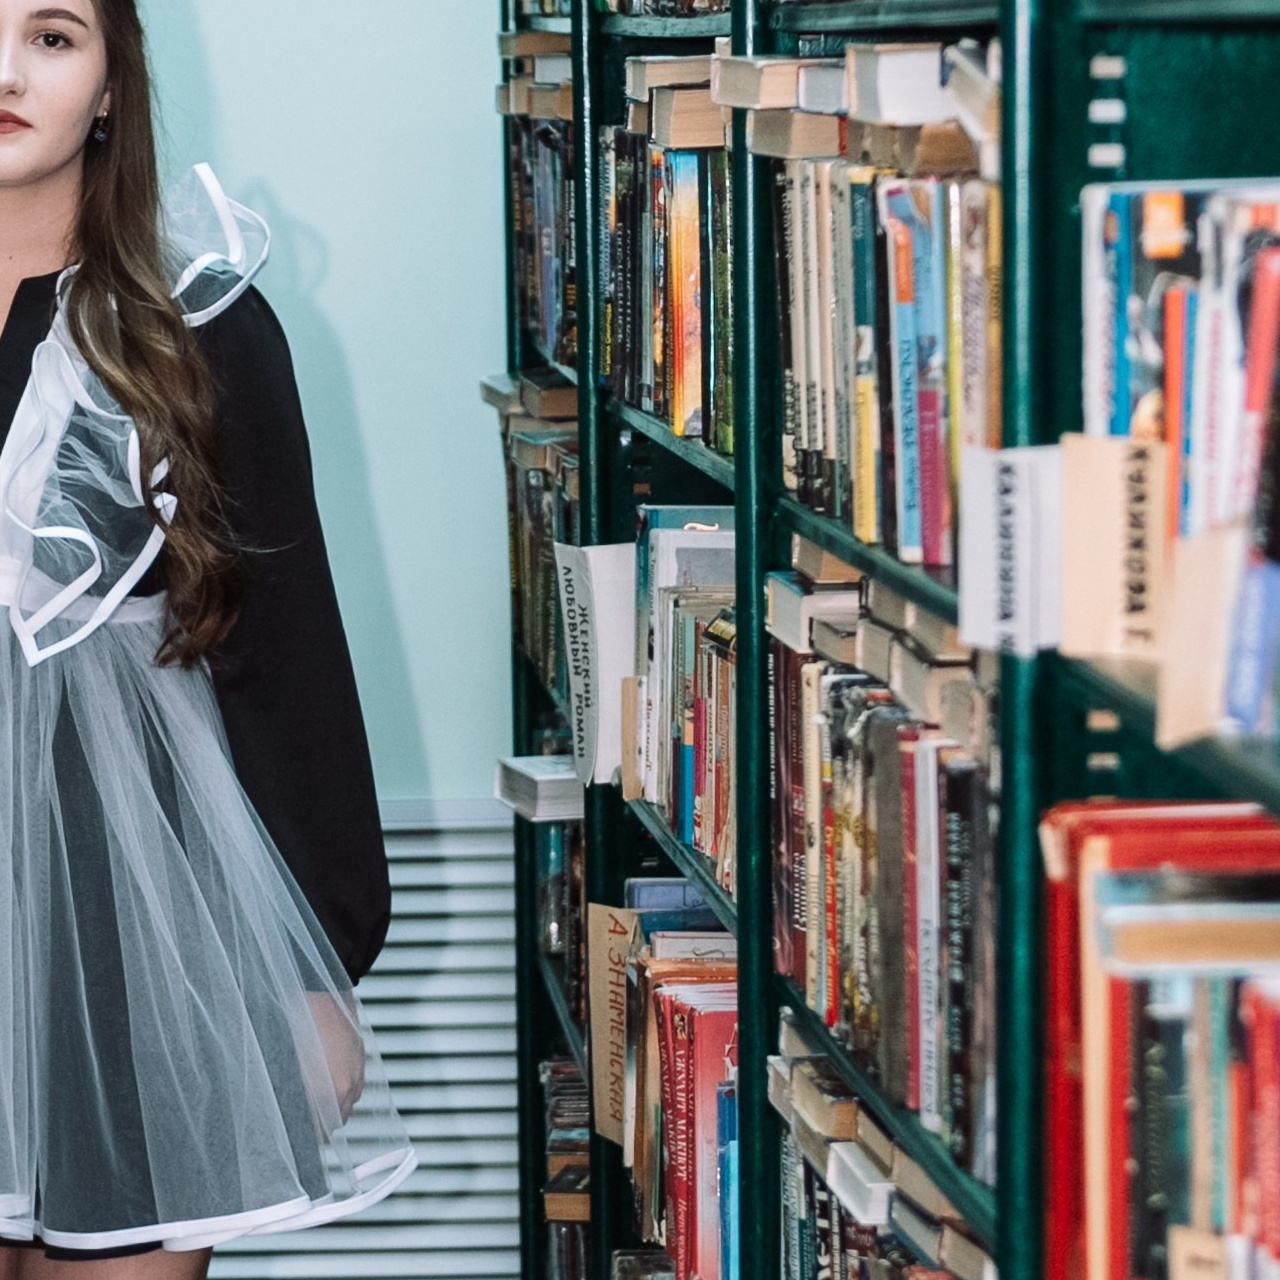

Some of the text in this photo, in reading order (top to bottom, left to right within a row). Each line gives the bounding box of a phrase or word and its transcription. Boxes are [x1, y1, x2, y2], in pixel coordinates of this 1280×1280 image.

[562, 565, 586, 759] ЛЮБОВНЫЙ РОМАН
[577, 603, 594, 709] ЖЕНСКИЙ
[608, 947, 627, 1123] ЗНАМЕНСКАЯ
